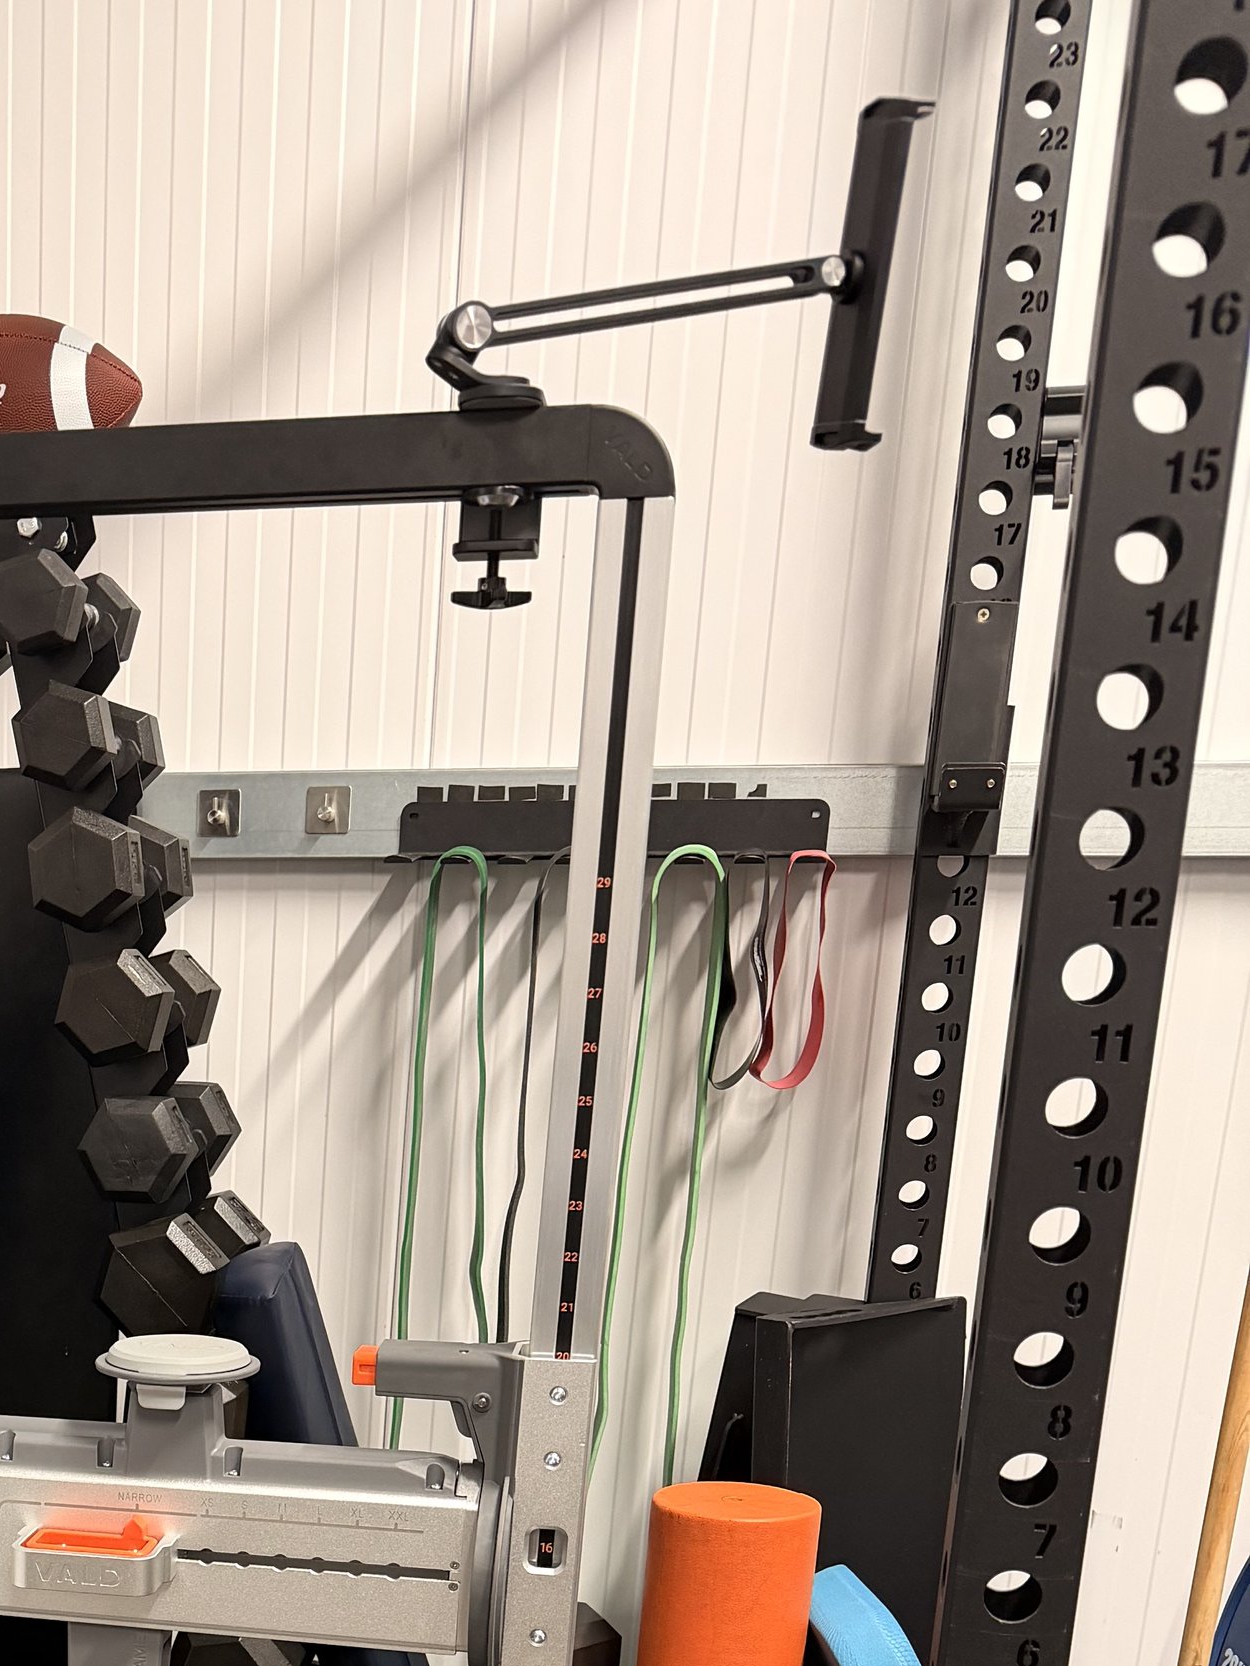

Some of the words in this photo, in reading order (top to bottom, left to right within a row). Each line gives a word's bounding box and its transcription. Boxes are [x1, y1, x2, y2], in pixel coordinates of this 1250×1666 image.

[1049, 42, 1079, 68] 23
[1039, 126, 1069, 152] 22
[1029, 209, 1058, 235] 21
[1020, 290, 1049, 314] 20
[1186, 291, 1243, 340] 16
[1012, 368, 1040, 394] 19
[1003, 446, 1031, 471] 18
[1165, 448, 1222, 494] 15
[994, 522, 1023, 547] 17
[1146, 599, 1200, 643] 14
[1127, 745, 1181, 788] 13
[596, 877, 612, 888] 29
[951, 886, 978, 907] 12
[1108, 887, 1161, 928] 12
[592, 932, 607, 944] 28
[943, 955, 966, 976] 11
[587, 987, 603, 999] 27
[935, 1023, 961, 1043] 10
[1091, 1023, 1134, 1063] 11
[583, 1042, 598, 1053] 26
[578, 1096, 593, 1107] 25
[932, 1088, 945, 1109] 9
[573, 1149, 587, 1159] 24
[924, 1153, 938, 1173] 8
[1074, 1155, 1123, 1194] 10
[569, 1200, 583, 1211] 23
[917, 1218, 930, 1237] 7
[564, 1252, 578, 1262] 22
[908, 1281, 922, 1300] 6
[1065, 1281, 1089, 1318] 9
[560, 1302, 574, 1312] 21
[556, 1352, 570, 1361] 20
[1048, 1404, 1072, 1441] 8
[117, 1491, 162, 1503] NARROW
[350, 1507, 364, 1518] XL
[388, 1510, 409, 1522] XXL
[540, 1543, 553, 1553] 16
[1033, 1522, 1057, 1559] 7
[34, 1560, 121, 1588] VALD
